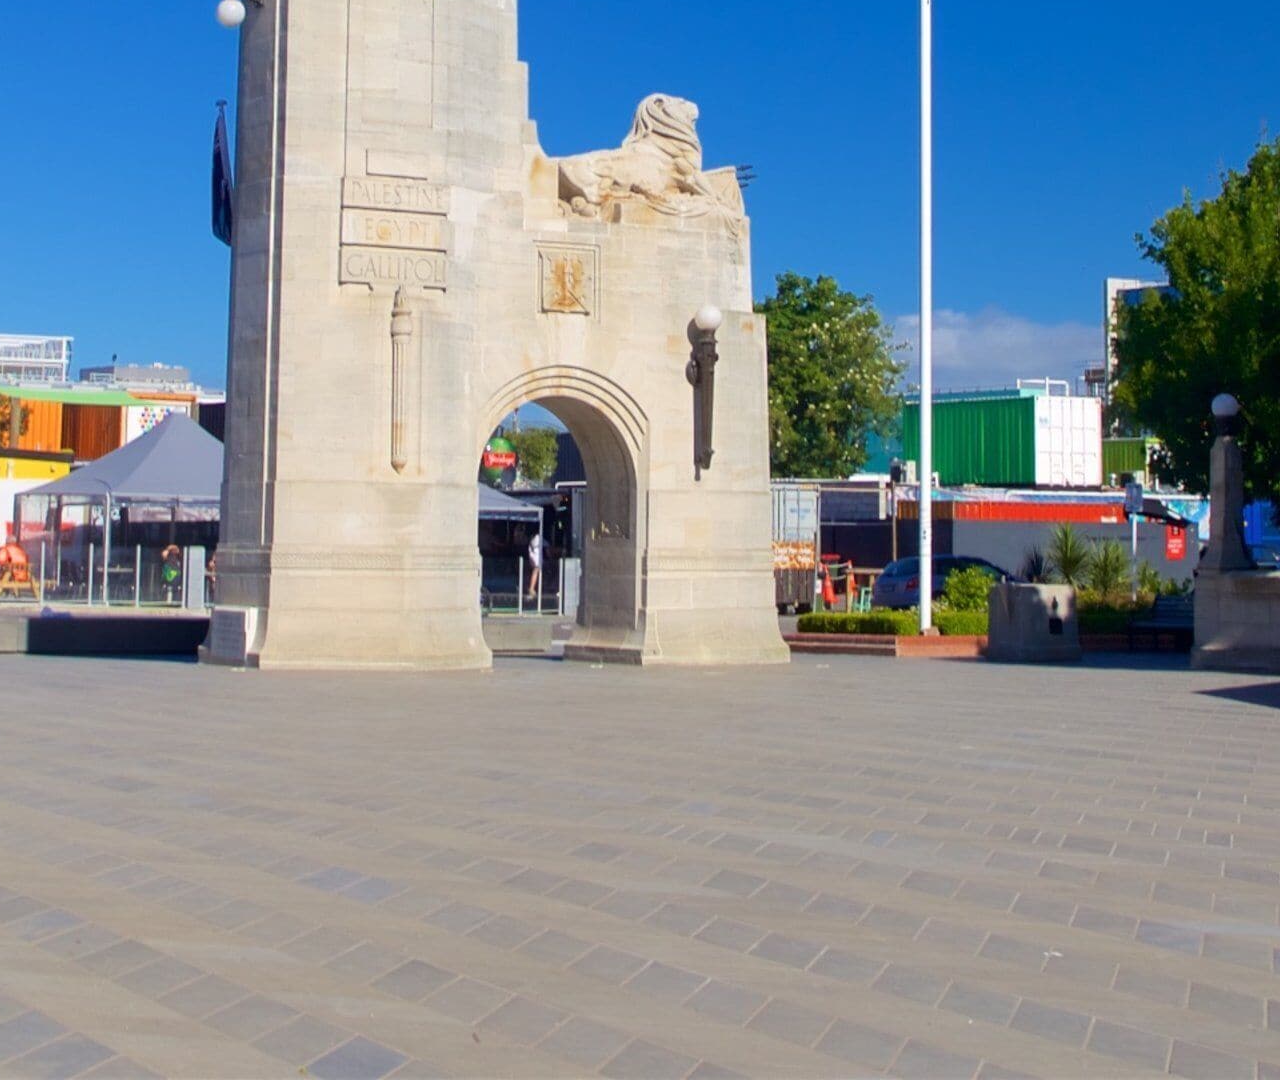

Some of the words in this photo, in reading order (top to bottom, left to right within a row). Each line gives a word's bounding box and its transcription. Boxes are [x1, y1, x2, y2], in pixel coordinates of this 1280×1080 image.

[351, 180, 445, 210] PALESTINE
[364, 217, 431, 245] EGYPT
[345, 254, 447, 283] GALLIPOLI
